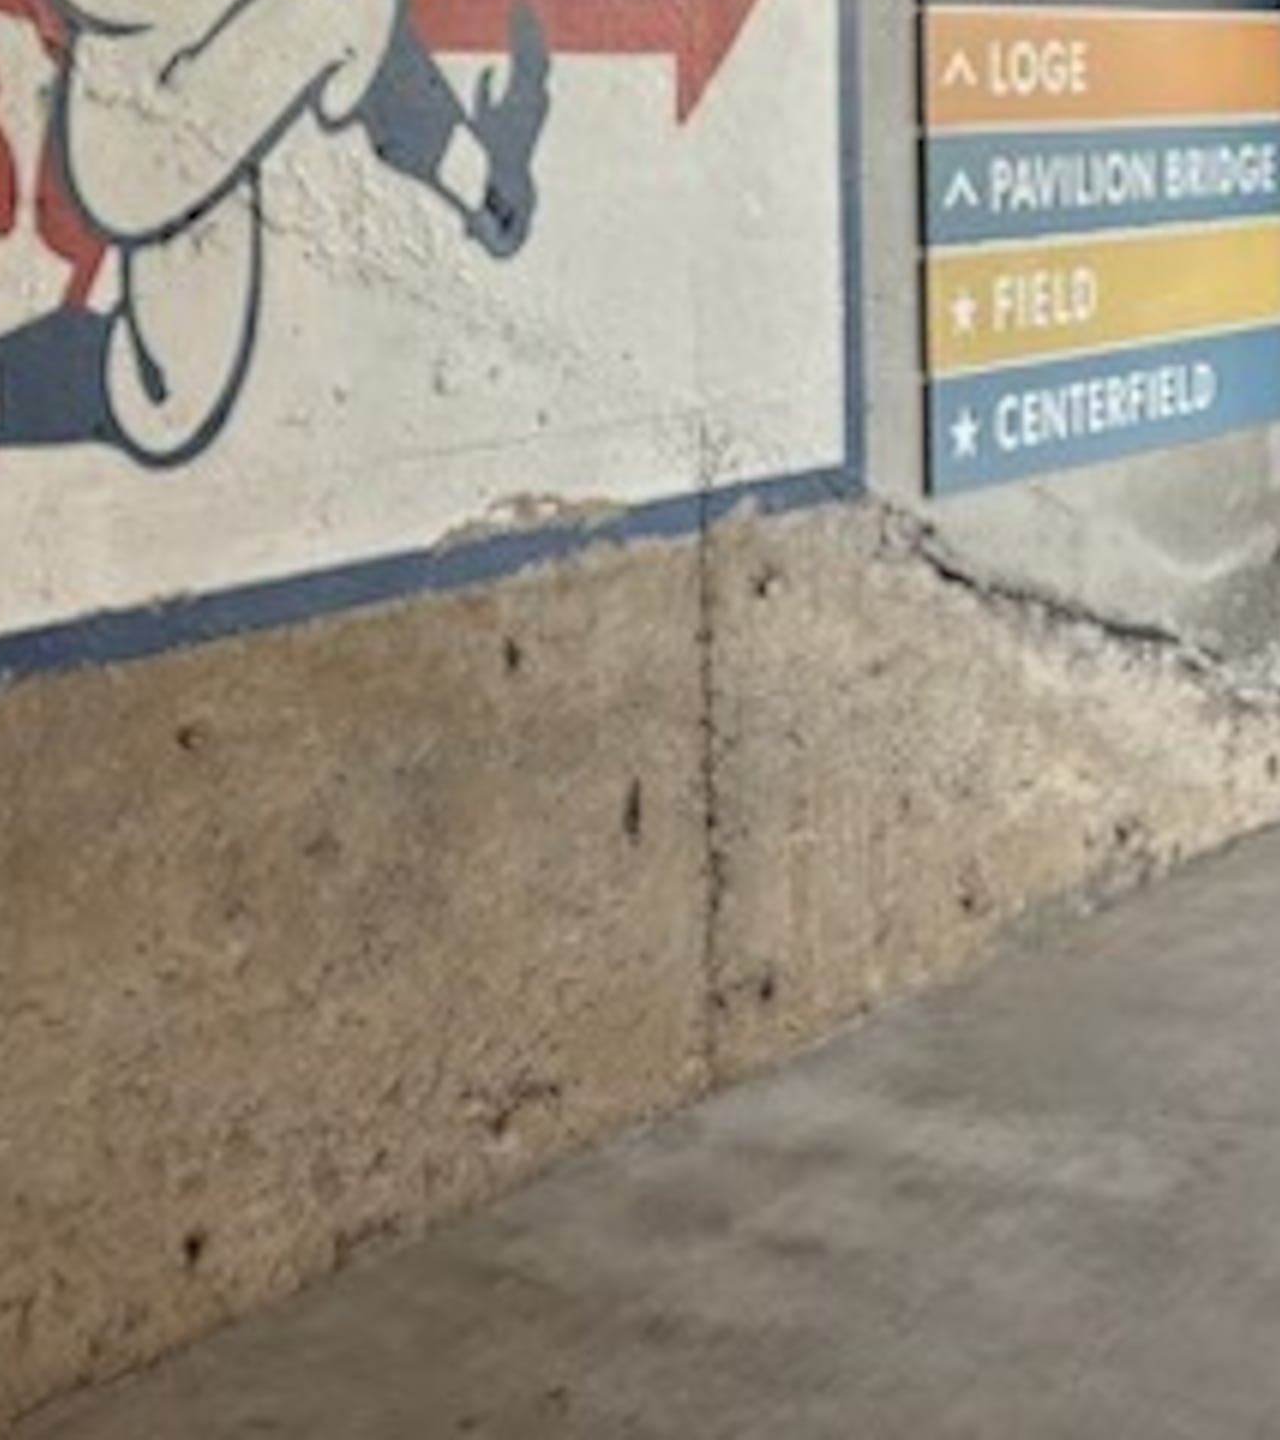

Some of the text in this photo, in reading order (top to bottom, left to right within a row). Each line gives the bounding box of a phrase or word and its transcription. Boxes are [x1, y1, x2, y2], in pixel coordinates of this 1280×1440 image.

[989, 40, 1088, 94] LOGE
[990, 142, 1277, 214] PAVILION BRIDGE
[992, 270, 1098, 332] FIELD
[993, 363, 1217, 451] CENTERFIELD
